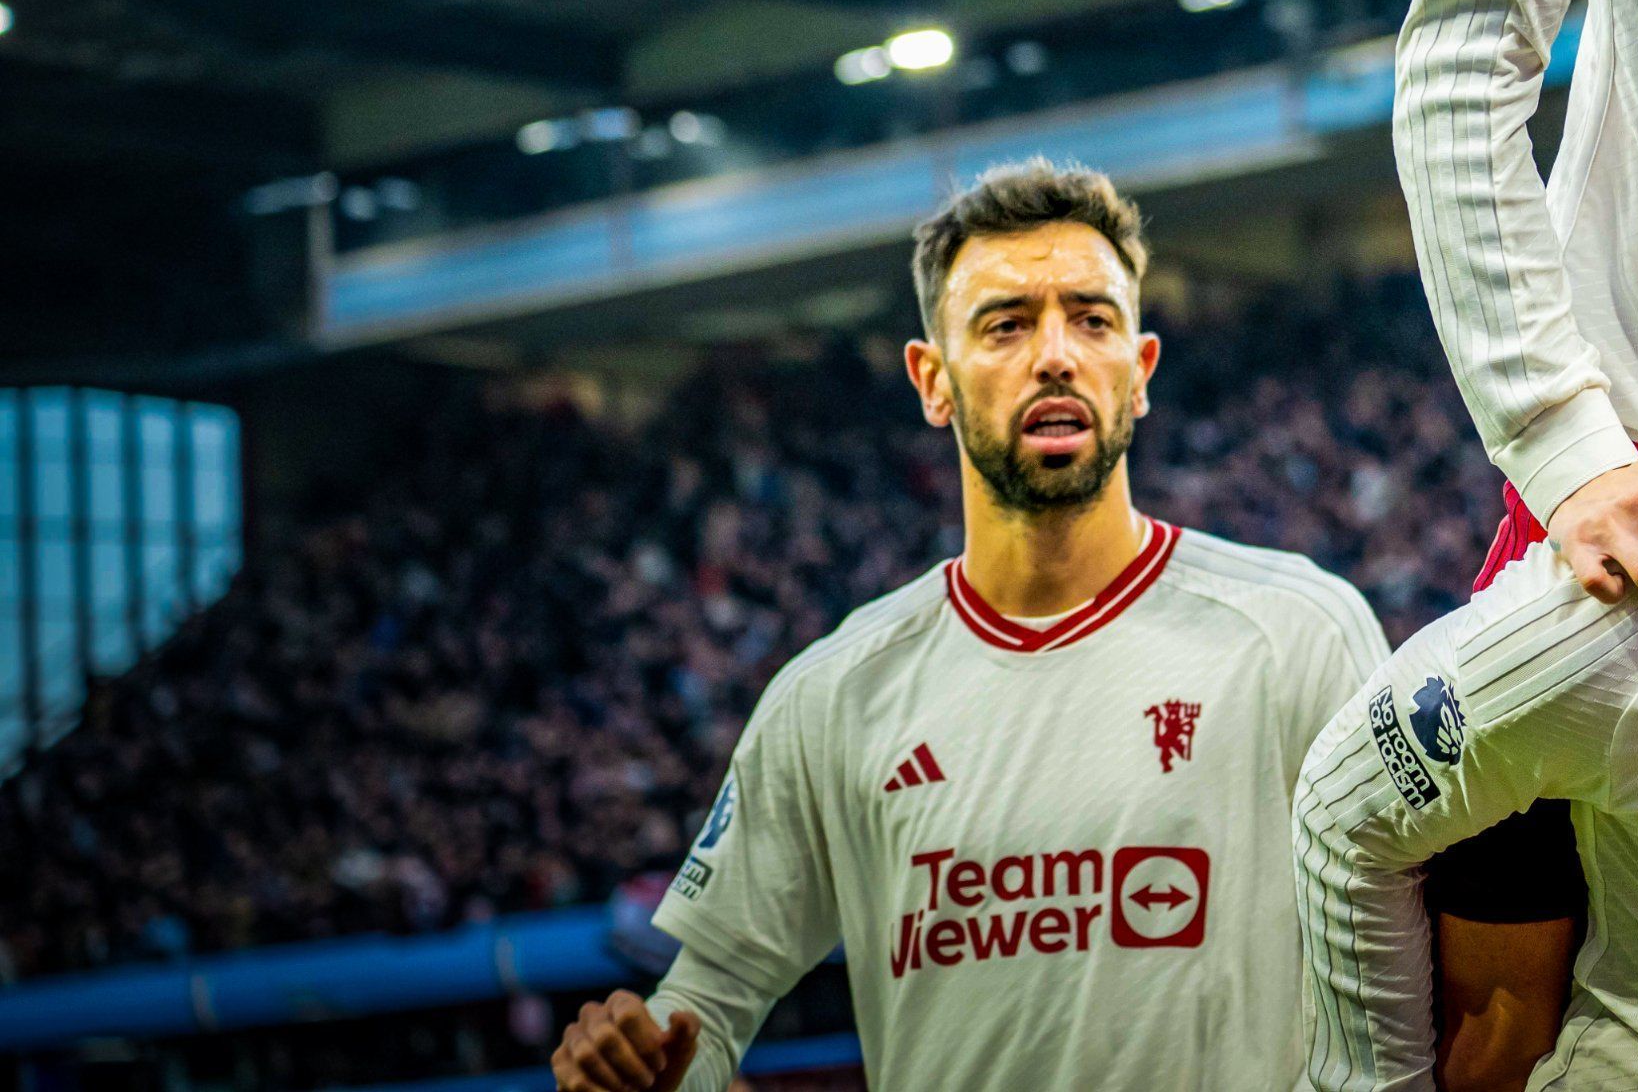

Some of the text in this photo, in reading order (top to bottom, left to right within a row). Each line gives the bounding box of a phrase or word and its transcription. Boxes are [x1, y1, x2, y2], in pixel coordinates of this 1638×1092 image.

[1370, 694, 1425, 808] for racism
[1379, 687, 1430, 792] No room
[911, 847, 1104, 911] Team
[890, 903, 1103, 980] Viewer
